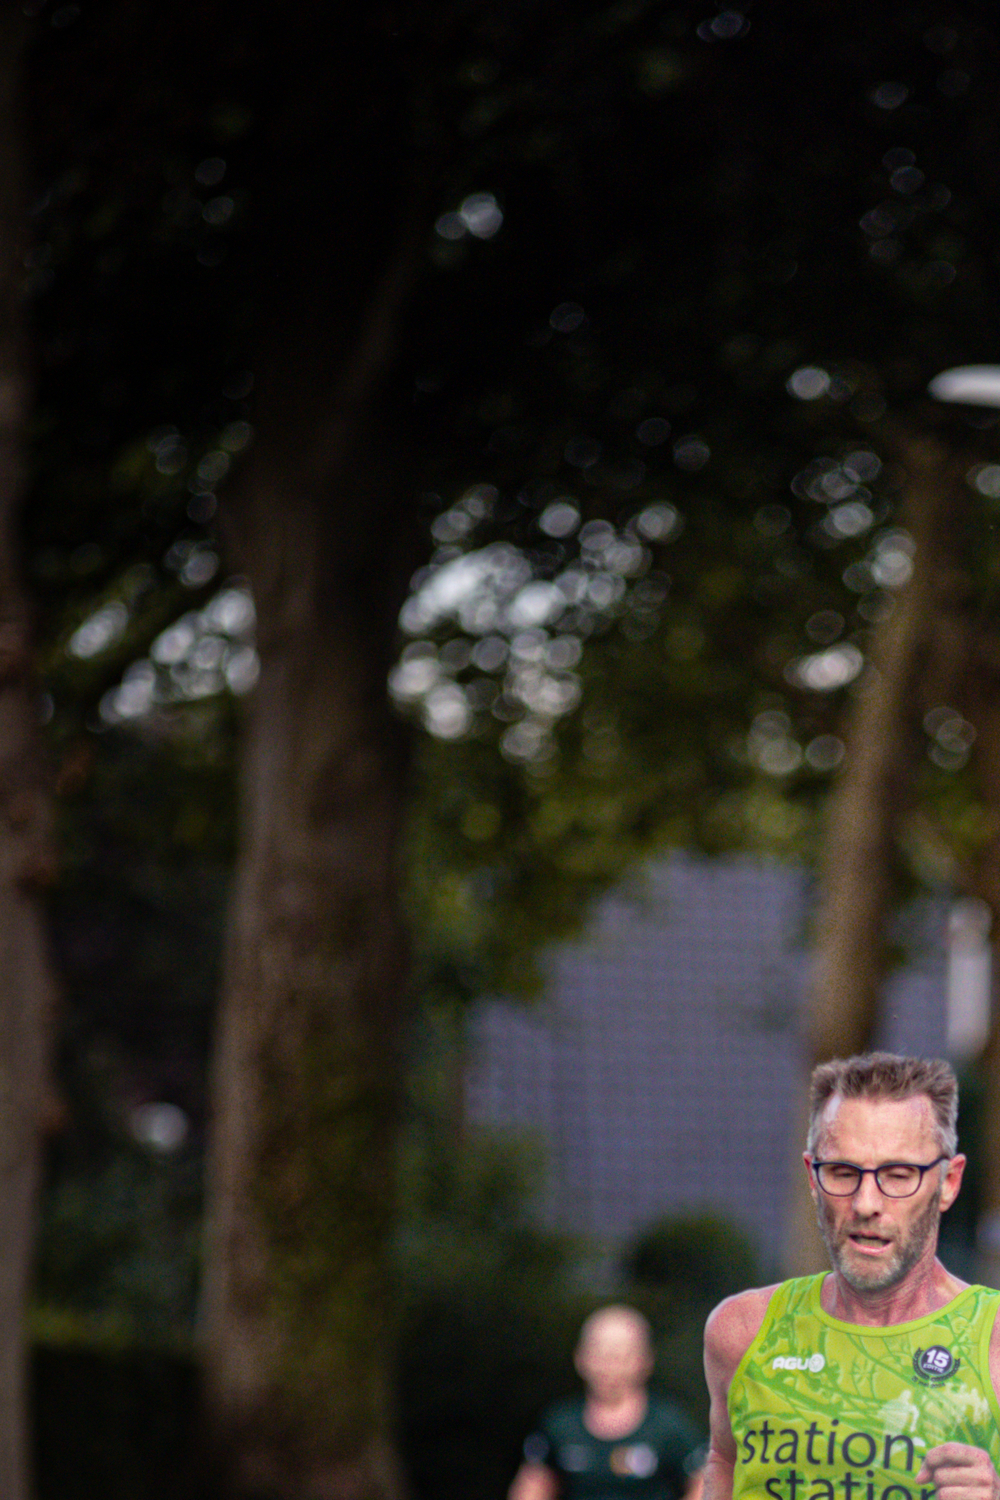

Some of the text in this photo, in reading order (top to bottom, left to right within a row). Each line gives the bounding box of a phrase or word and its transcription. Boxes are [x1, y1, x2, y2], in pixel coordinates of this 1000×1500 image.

[773, 1356, 809, 1370] AGU
[926, 1349, 950, 1368] 15
[742, 1419, 914, 1472] station
